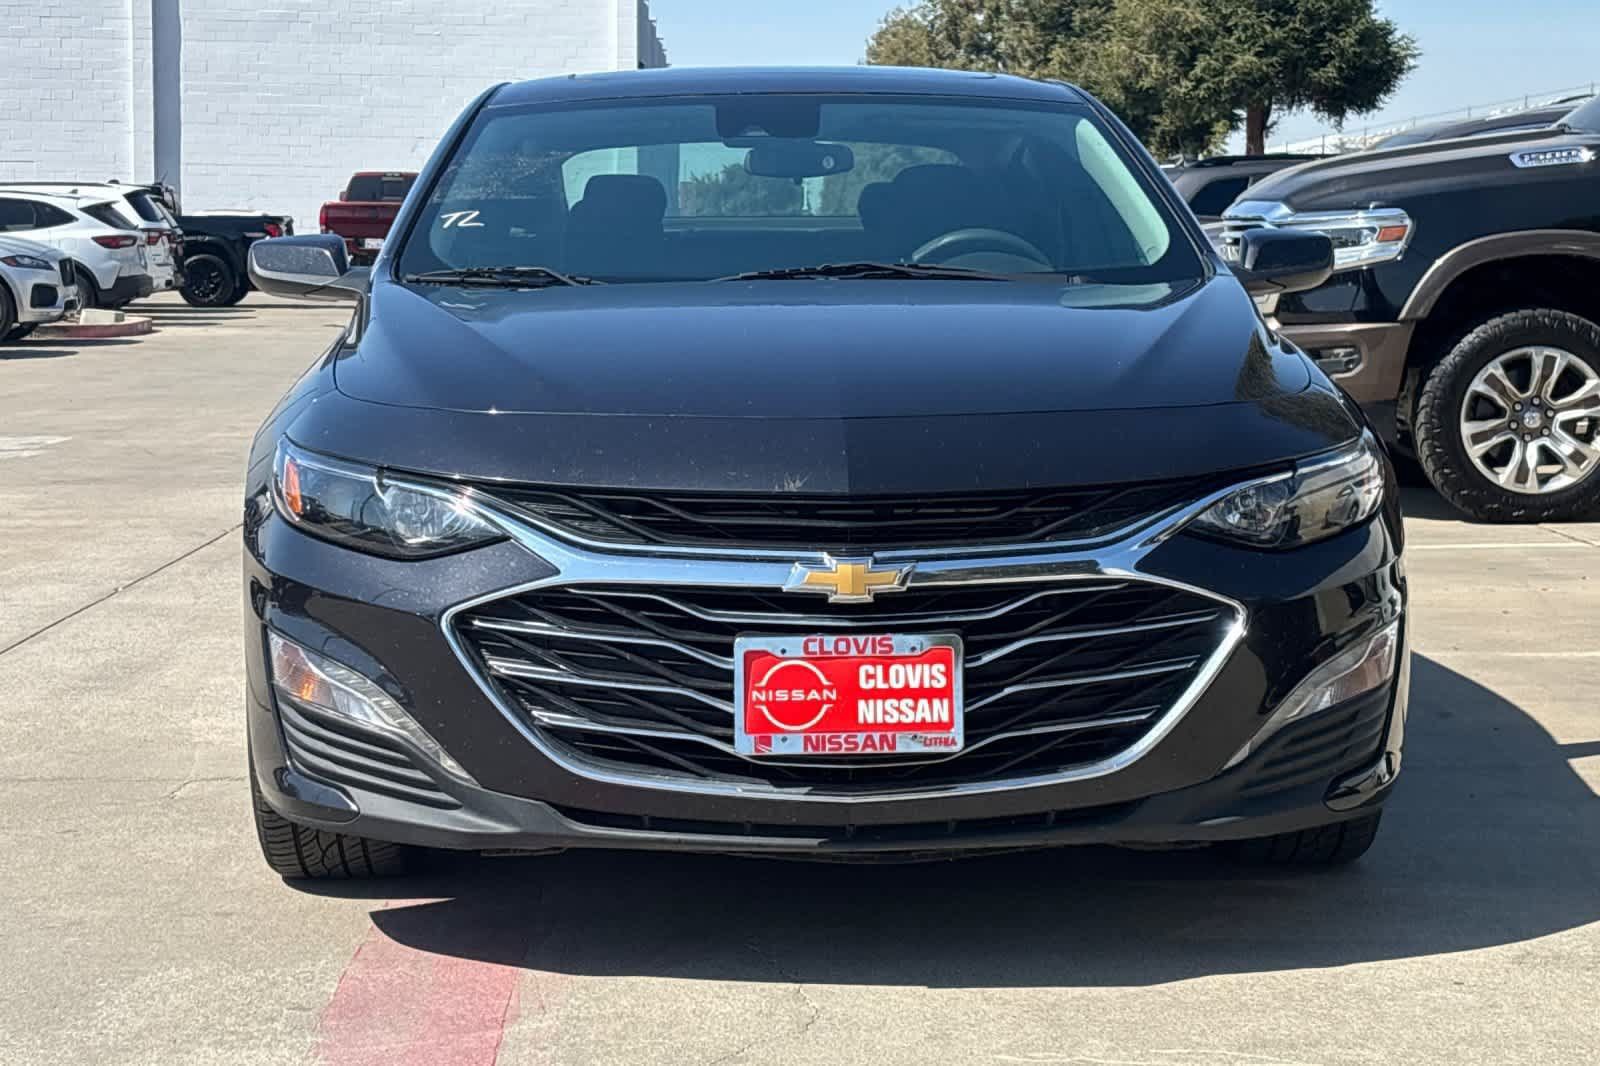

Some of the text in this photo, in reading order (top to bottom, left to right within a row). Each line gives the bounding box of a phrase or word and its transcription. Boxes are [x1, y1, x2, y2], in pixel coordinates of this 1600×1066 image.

[802, 636, 894, 655] CLOVIS
[858, 663, 947, 689] CLOVIS
[752, 688, 836, 701] NISSAN
[857, 698, 949, 724] NISSAN
[803, 733, 897, 752] NISSAN
